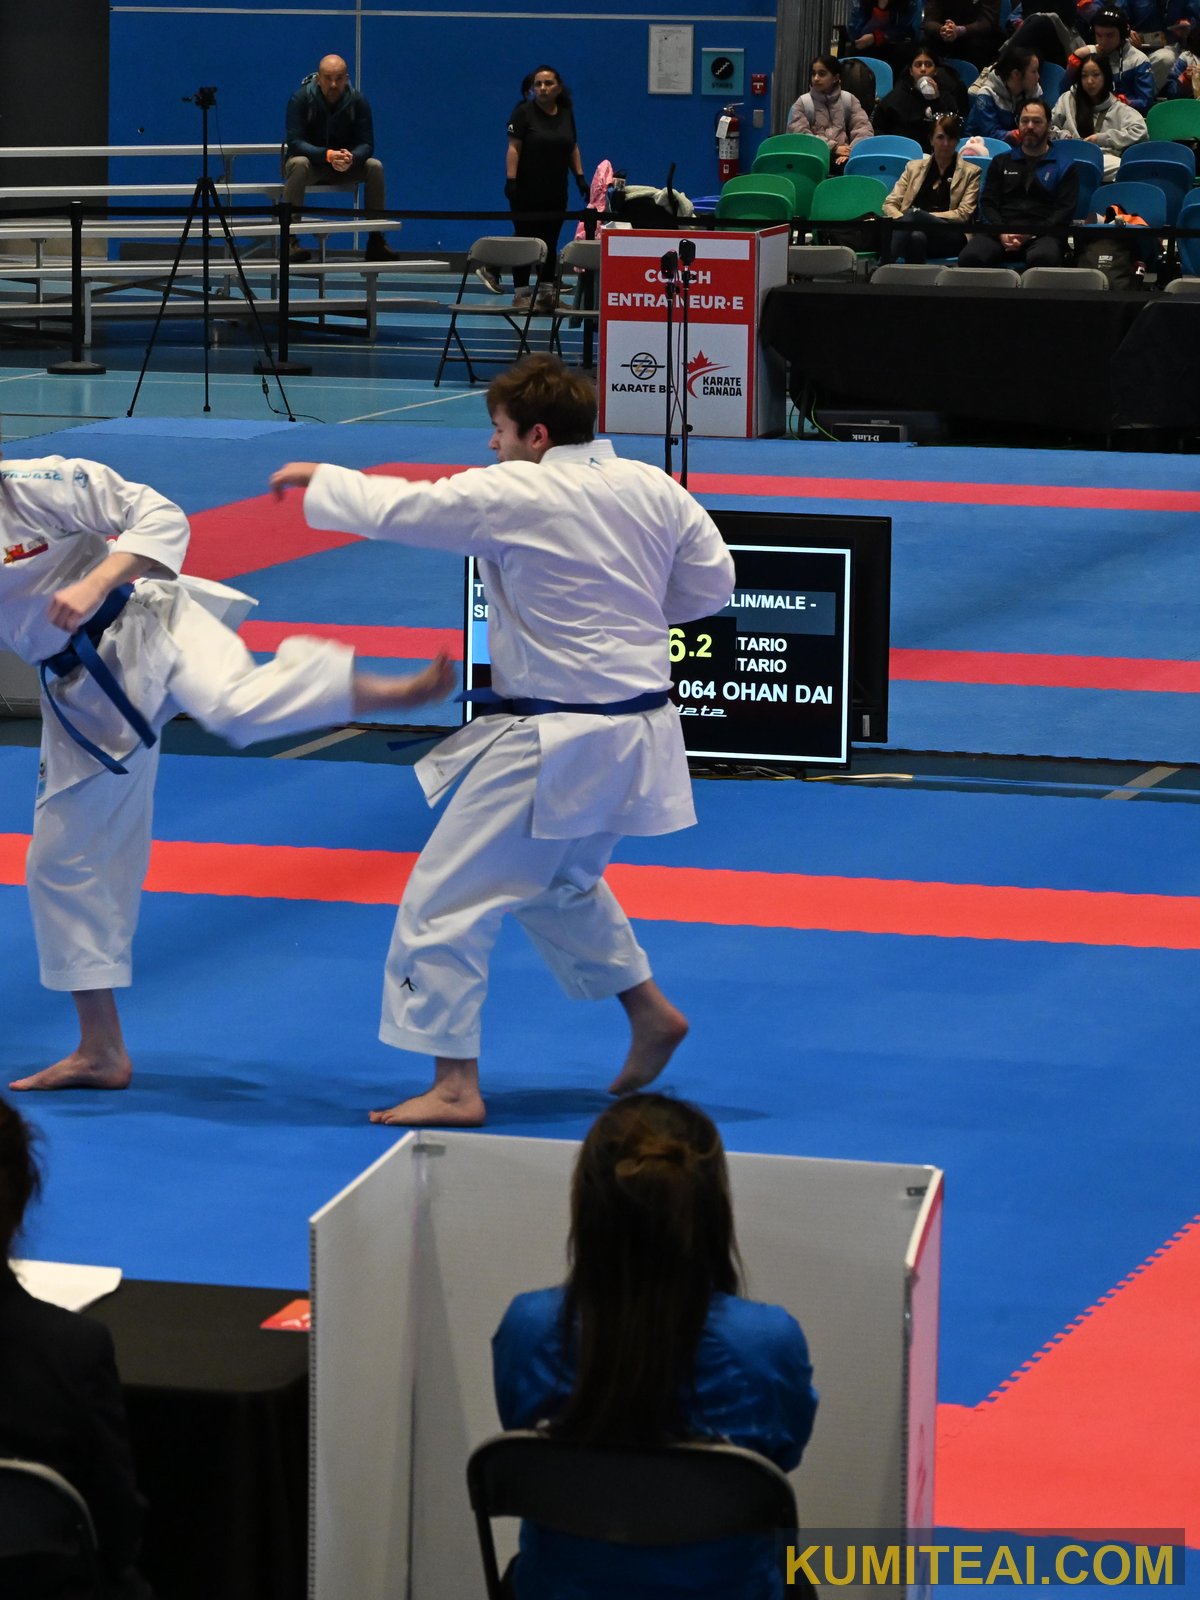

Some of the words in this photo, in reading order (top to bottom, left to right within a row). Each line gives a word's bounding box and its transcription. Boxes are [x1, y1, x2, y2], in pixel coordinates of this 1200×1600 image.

[611, 384, 656, 393] KARATE
[702, 376, 741, 386] KARATE
[702, 386, 742, 396] CANADA
[725, 594, 806, 610] LIN/MALE
[736, 637, 787, 652] TARIO
[735, 658, 787, 673] TARIO
[678, 680, 716, 699] 064
[722, 682, 788, 702] OHAN
[795, 685, 833, 704] DAI
